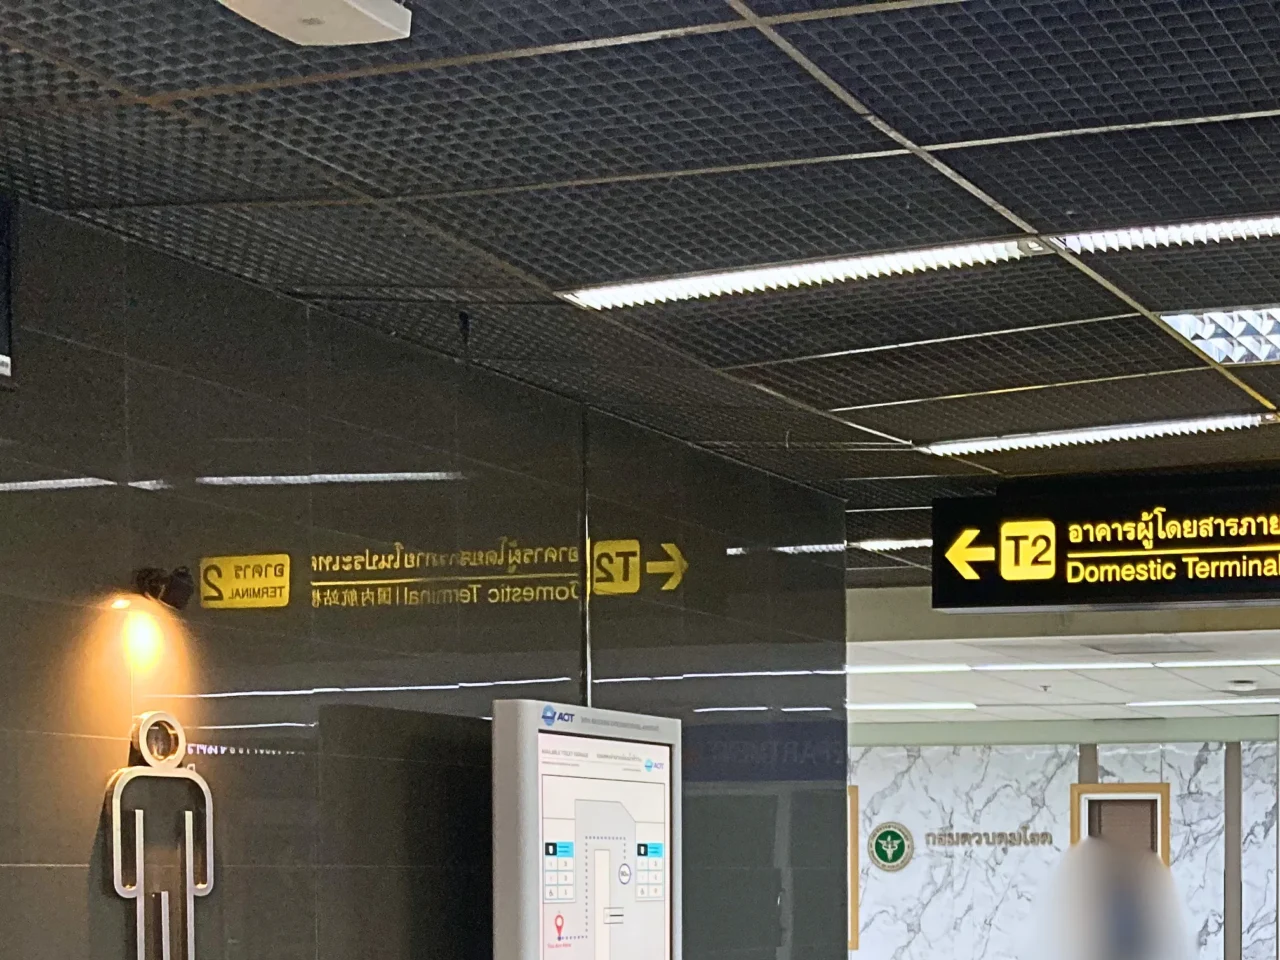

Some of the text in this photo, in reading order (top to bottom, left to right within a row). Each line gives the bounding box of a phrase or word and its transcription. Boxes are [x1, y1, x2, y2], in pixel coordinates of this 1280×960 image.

[1005, 534, 1053, 567] T2
[1067, 558, 1177, 584] Domestic
[556, 711, 575, 724] AOT
